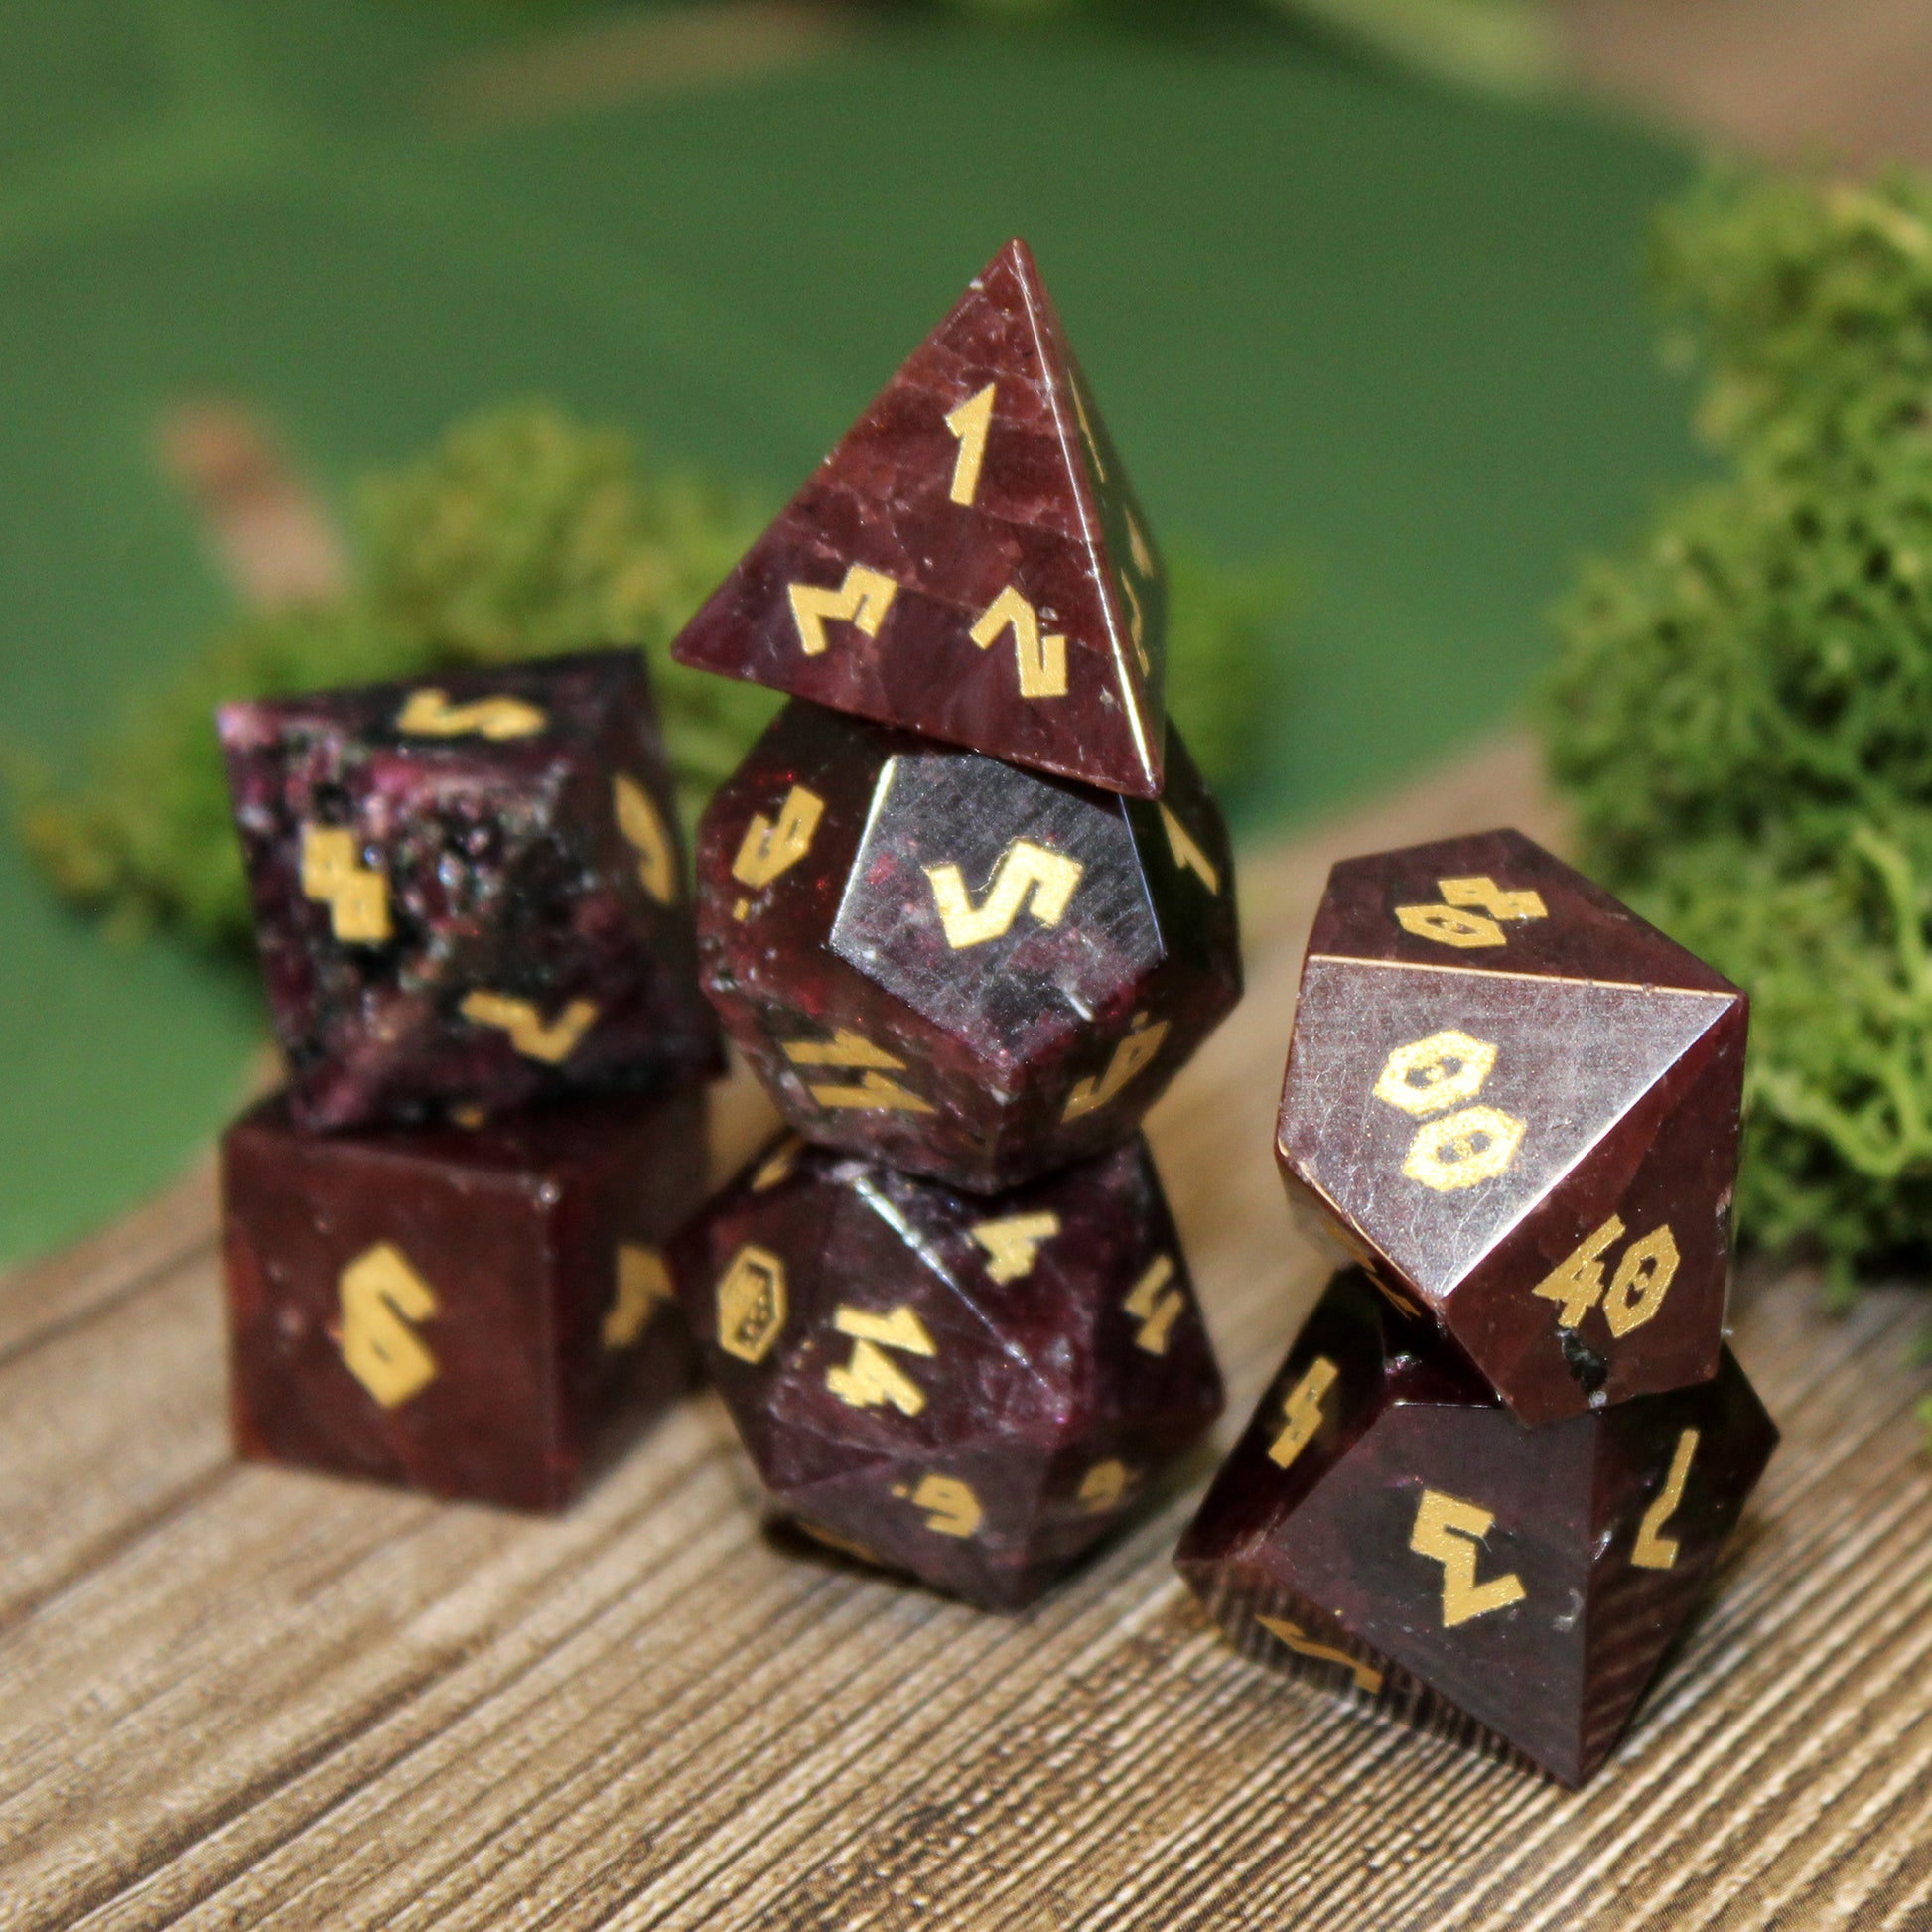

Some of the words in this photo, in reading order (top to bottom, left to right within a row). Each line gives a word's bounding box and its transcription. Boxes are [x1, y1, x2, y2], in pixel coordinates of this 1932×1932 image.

[943, 382, 998, 508] 1
[1371, 1028, 1528, 1193] 00
[1531, 1212, 1681, 1339] 40
